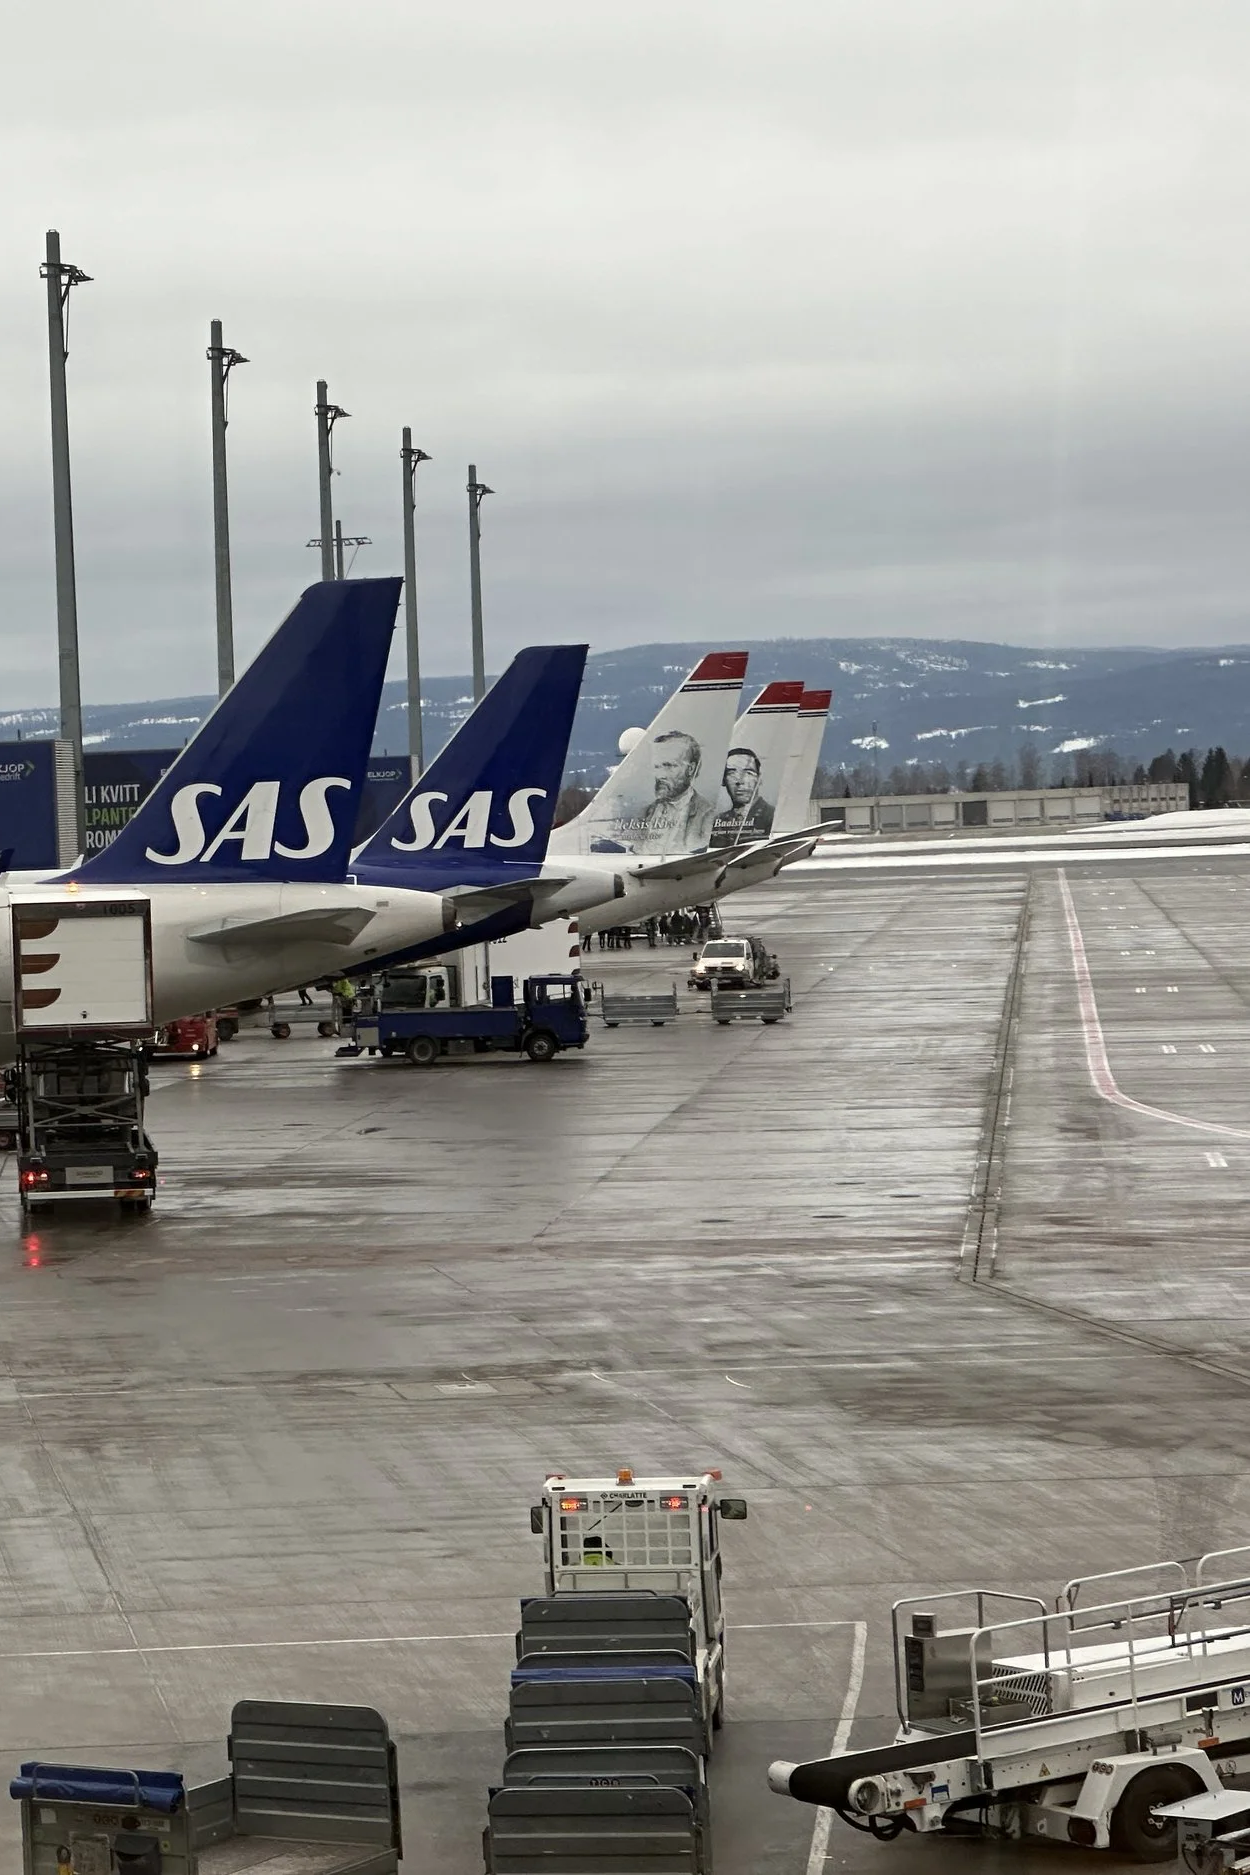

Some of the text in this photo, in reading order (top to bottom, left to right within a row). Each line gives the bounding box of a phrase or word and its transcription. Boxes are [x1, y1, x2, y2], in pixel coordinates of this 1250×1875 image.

[84, 784, 140, 804] LI KVITT
[145, 776, 351, 865] SAS
[390, 787, 547, 852] SAS
